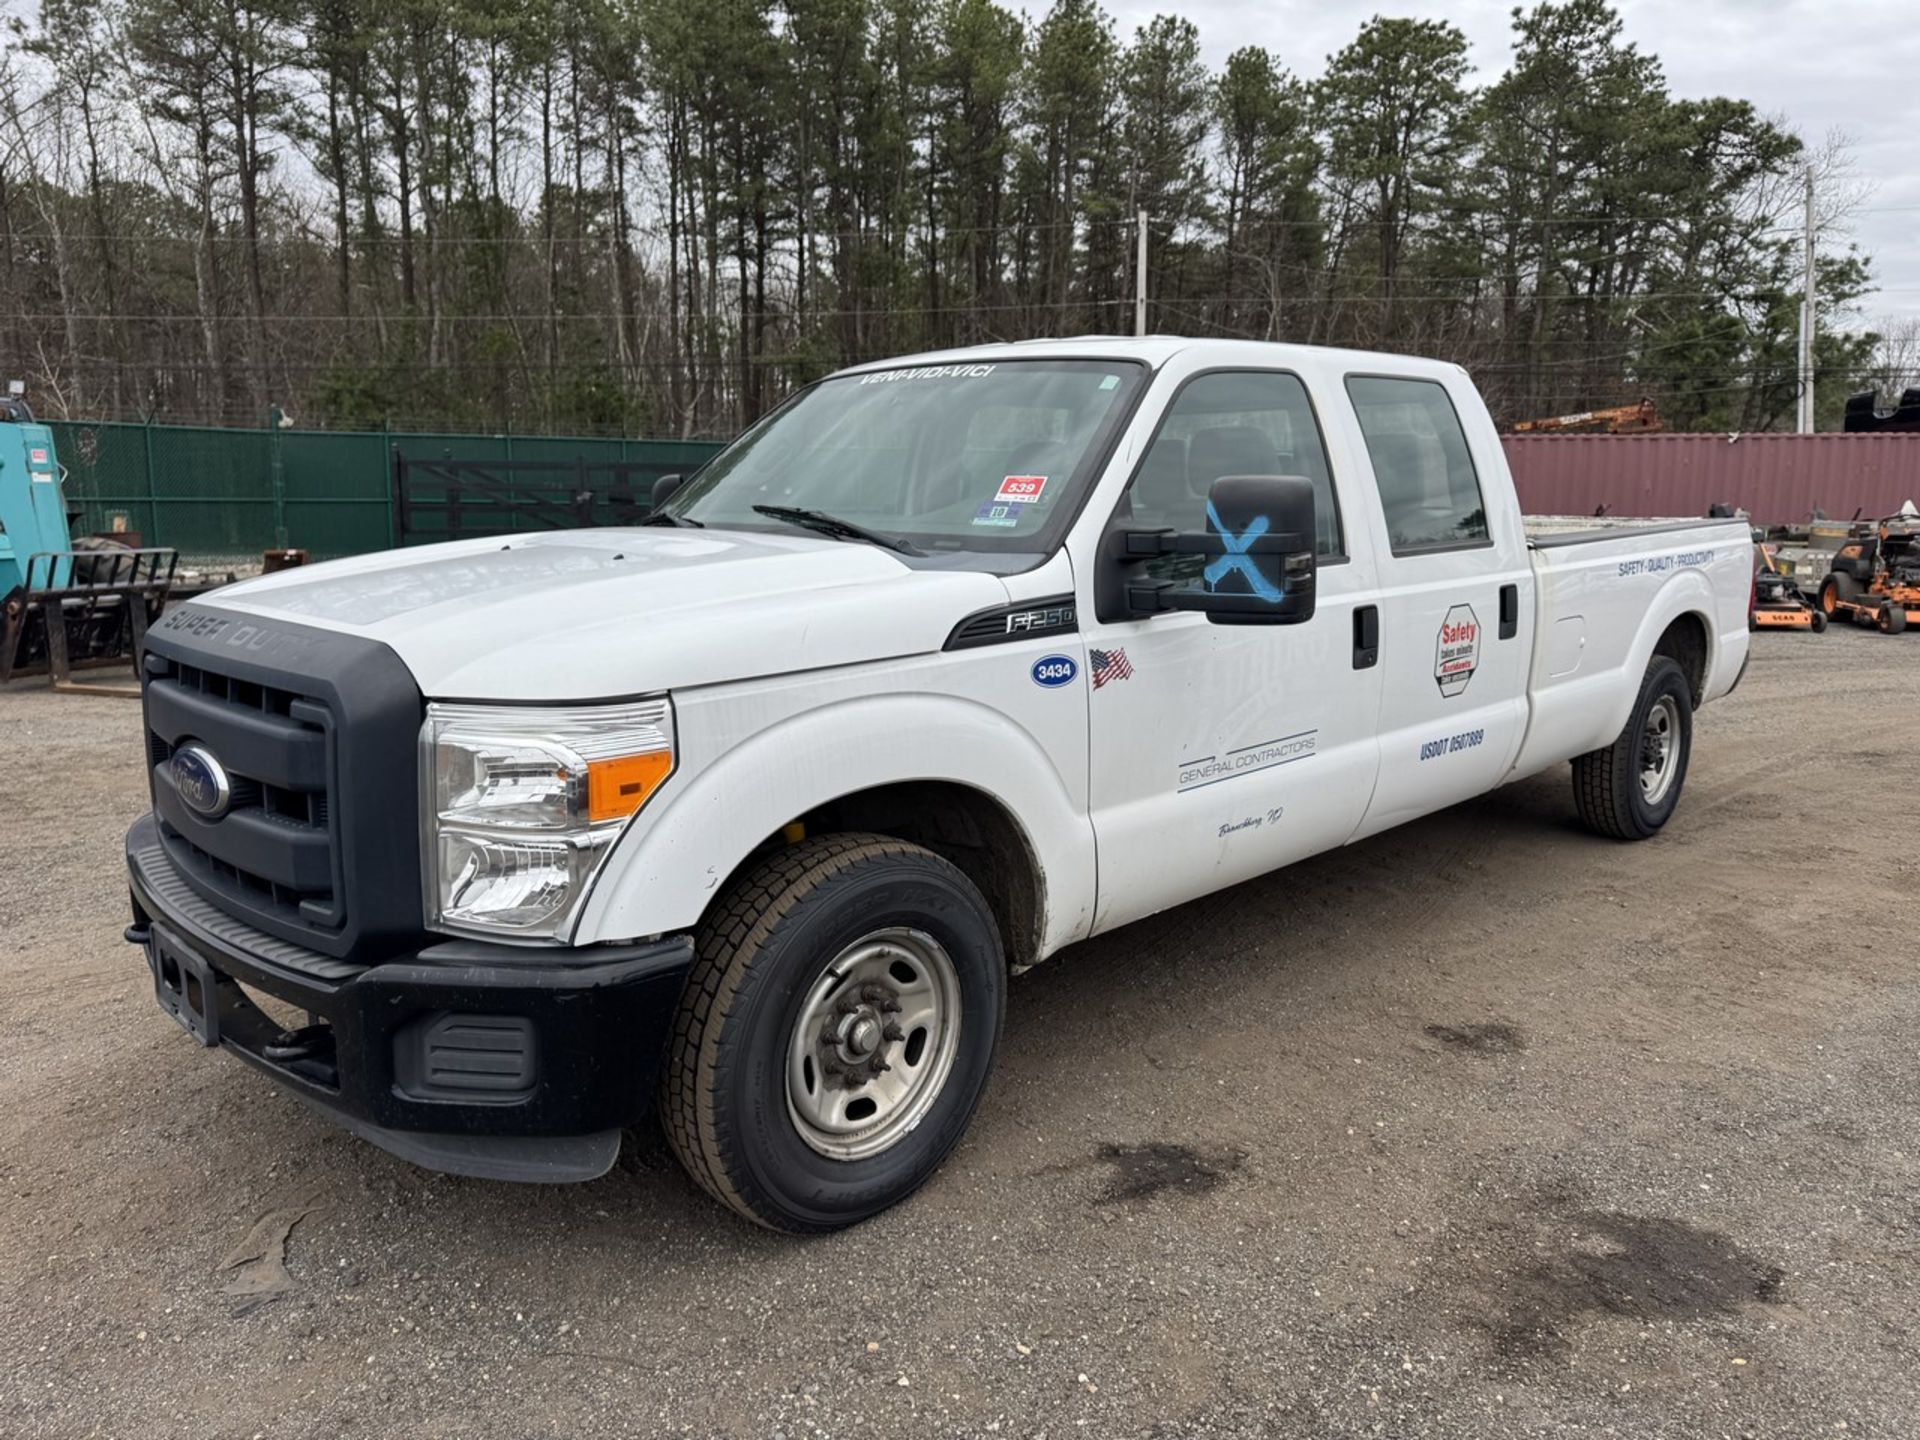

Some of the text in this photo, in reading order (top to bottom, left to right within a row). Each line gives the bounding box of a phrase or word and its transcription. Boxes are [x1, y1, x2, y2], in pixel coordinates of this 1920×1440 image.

[1007, 483, 1037, 493] 539
[1618, 560, 1644, 577] SAFETY
[1648, 556, 1674, 573] QUALITY
[1677, 550, 1715, 568] PRODUCTIVITY
[1442, 621, 1476, 645] Safety
[1038, 663, 1072, 680] 3434
[1179, 738, 1316, 784] GENERAL CONTRACTORS
[1420, 738, 1449, 761] USDOT
[175, 767, 203, 800] Ford
